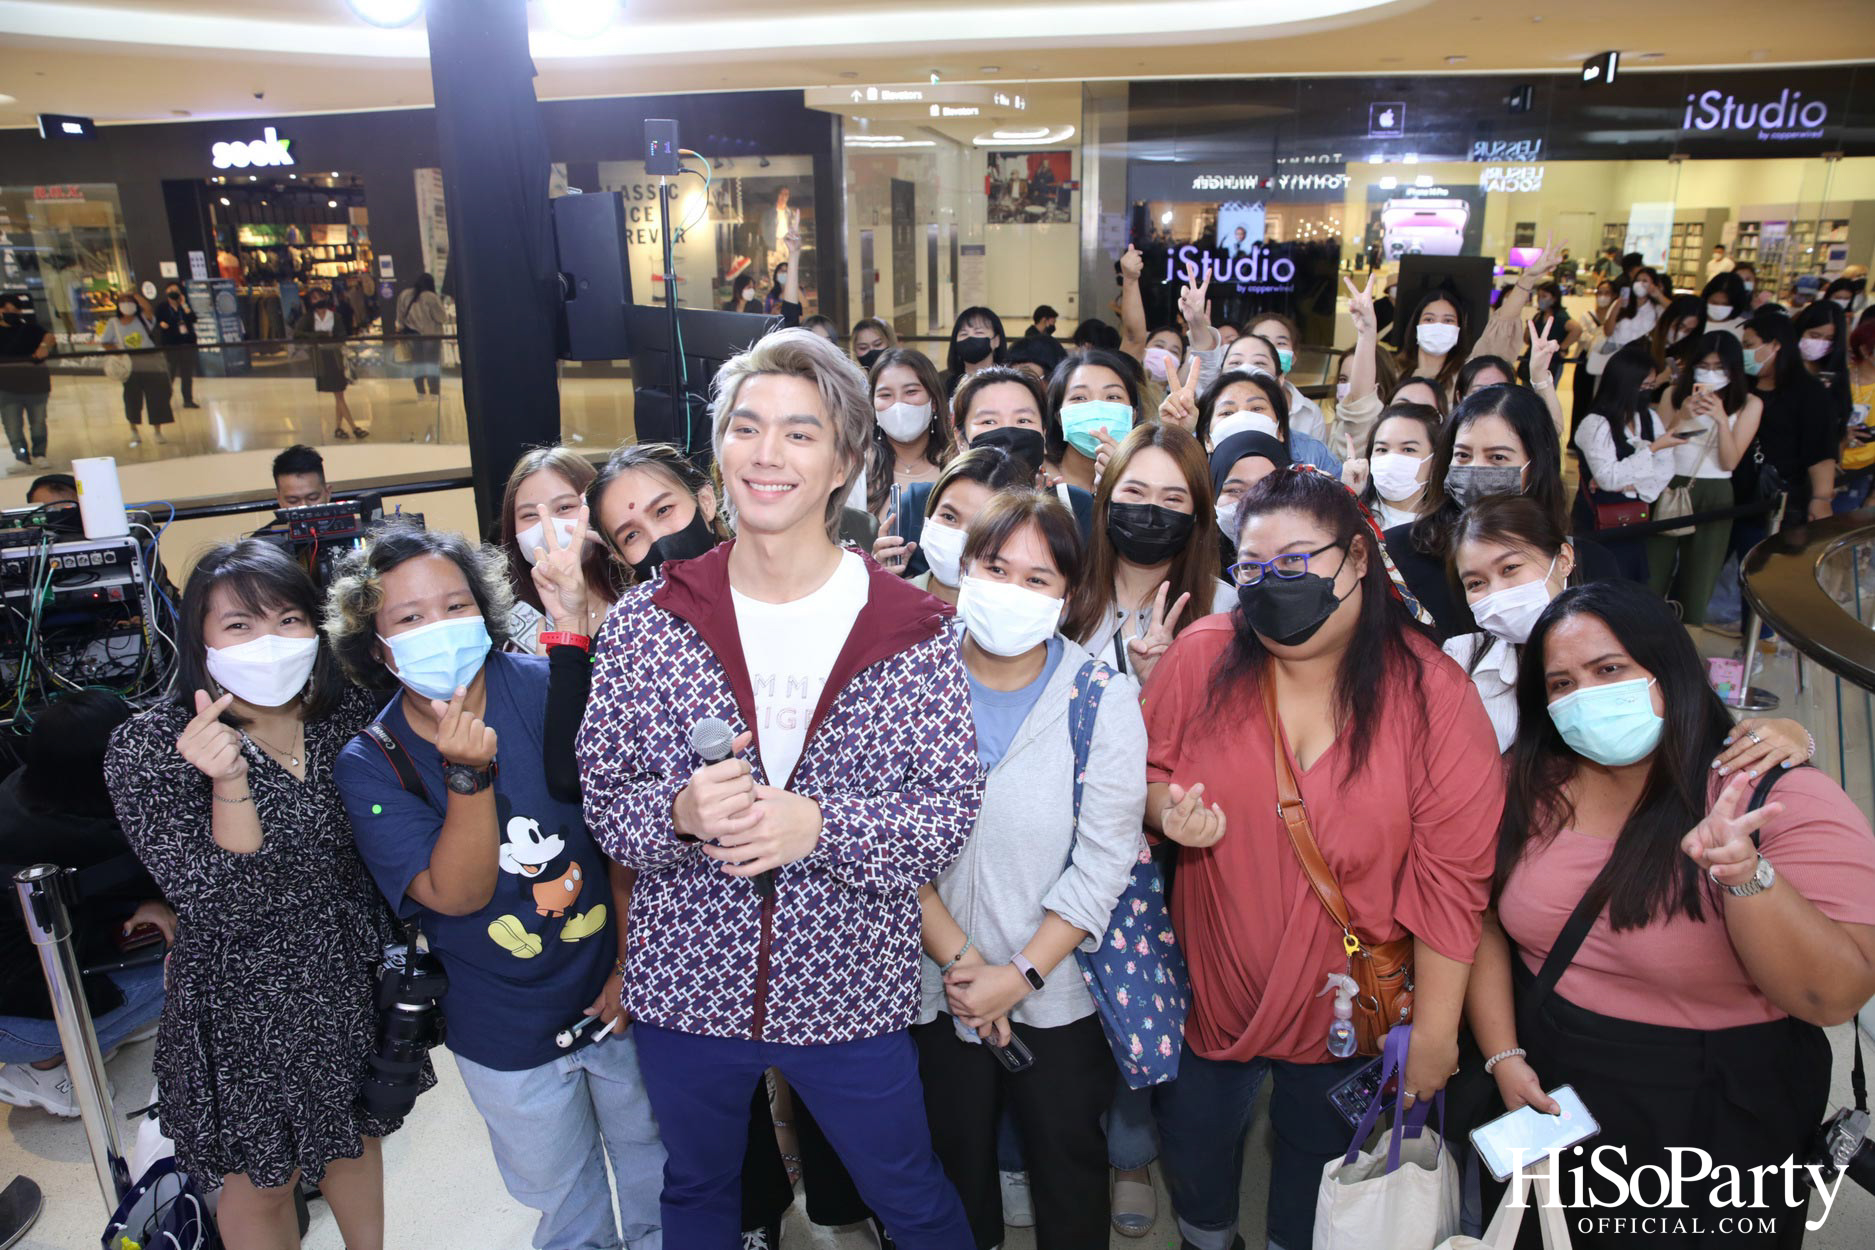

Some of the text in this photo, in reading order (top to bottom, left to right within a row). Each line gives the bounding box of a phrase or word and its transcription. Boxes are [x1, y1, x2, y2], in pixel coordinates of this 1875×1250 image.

[1683, 88, 1827, 130] iStudio
[1758, 128, 1824, 141] by copperwired
[1167, 245, 1295, 283] iStudio
[1236, 284, 1295, 294] by copperwired
